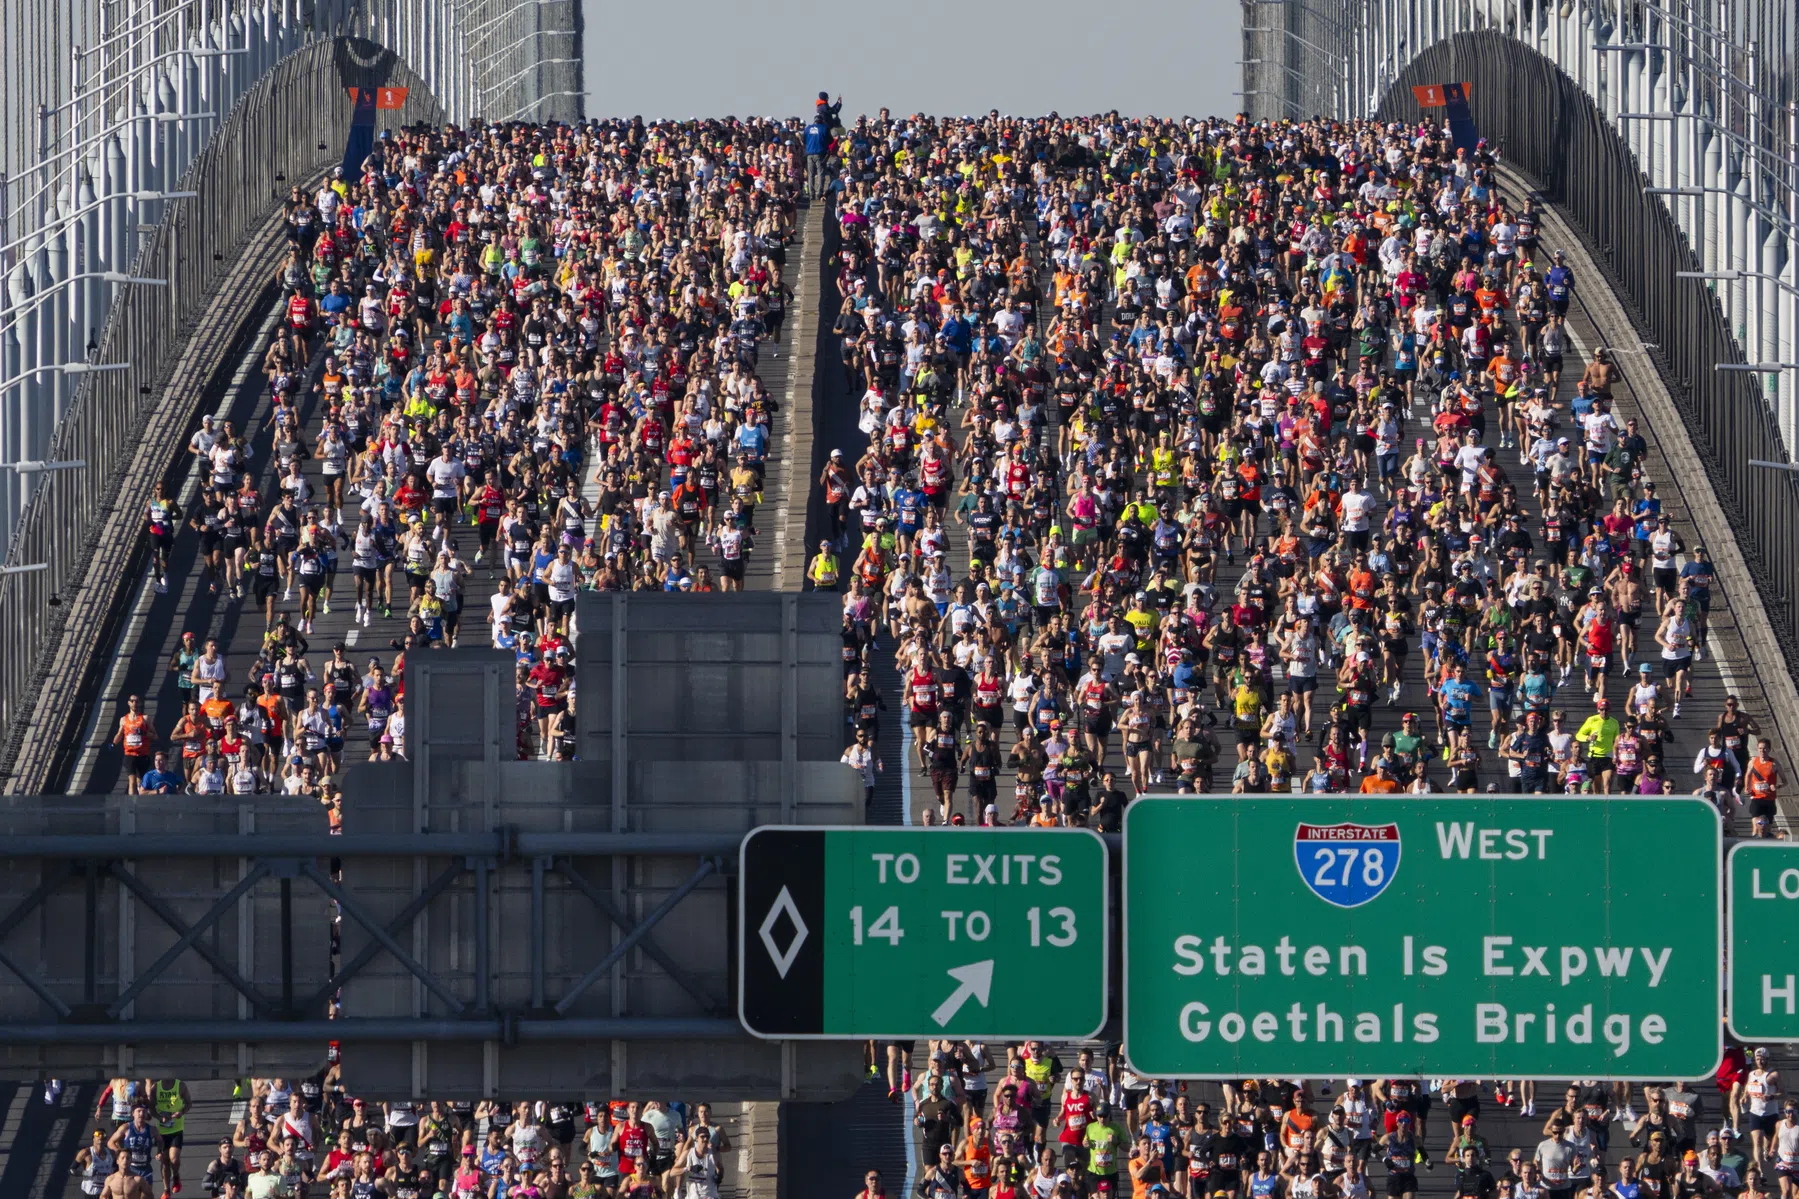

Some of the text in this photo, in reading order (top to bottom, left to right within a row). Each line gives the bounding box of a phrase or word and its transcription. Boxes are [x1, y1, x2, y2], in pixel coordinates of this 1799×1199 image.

[1307, 828, 1388, 840] INTERSTATE
[1435, 821, 1554, 861] WEST
[872, 853, 1063, 886] TO EXITS
[1314, 847, 1385, 887] 278
[849, 905, 1078, 948] 14 TO 13
[1172, 934, 1672, 988] Staten Is Expwy
[1761, 974, 1796, 1015] H
[1179, 1001, 1667, 1057] Goethals Bridge
[1067, 1103, 1084, 1112] VIC
[129, 1136, 151, 1146] USA
